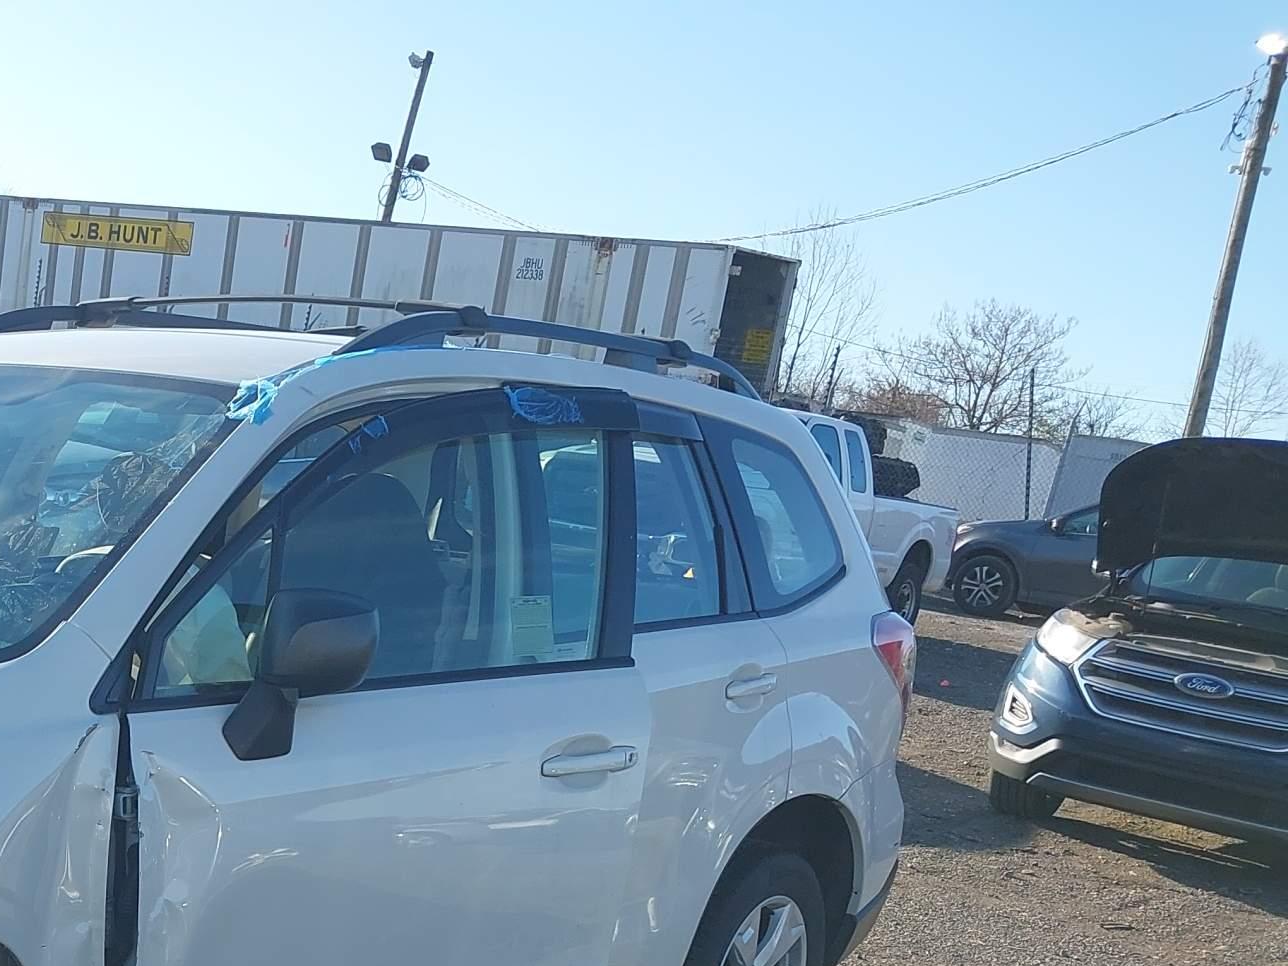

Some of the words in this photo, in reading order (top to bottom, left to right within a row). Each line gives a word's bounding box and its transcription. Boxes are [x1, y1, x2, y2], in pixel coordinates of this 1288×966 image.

[108, 223, 162, 245] HUNT
[520, 257, 544, 269] JBHU
[1187, 677, 1221, 693] Ford
